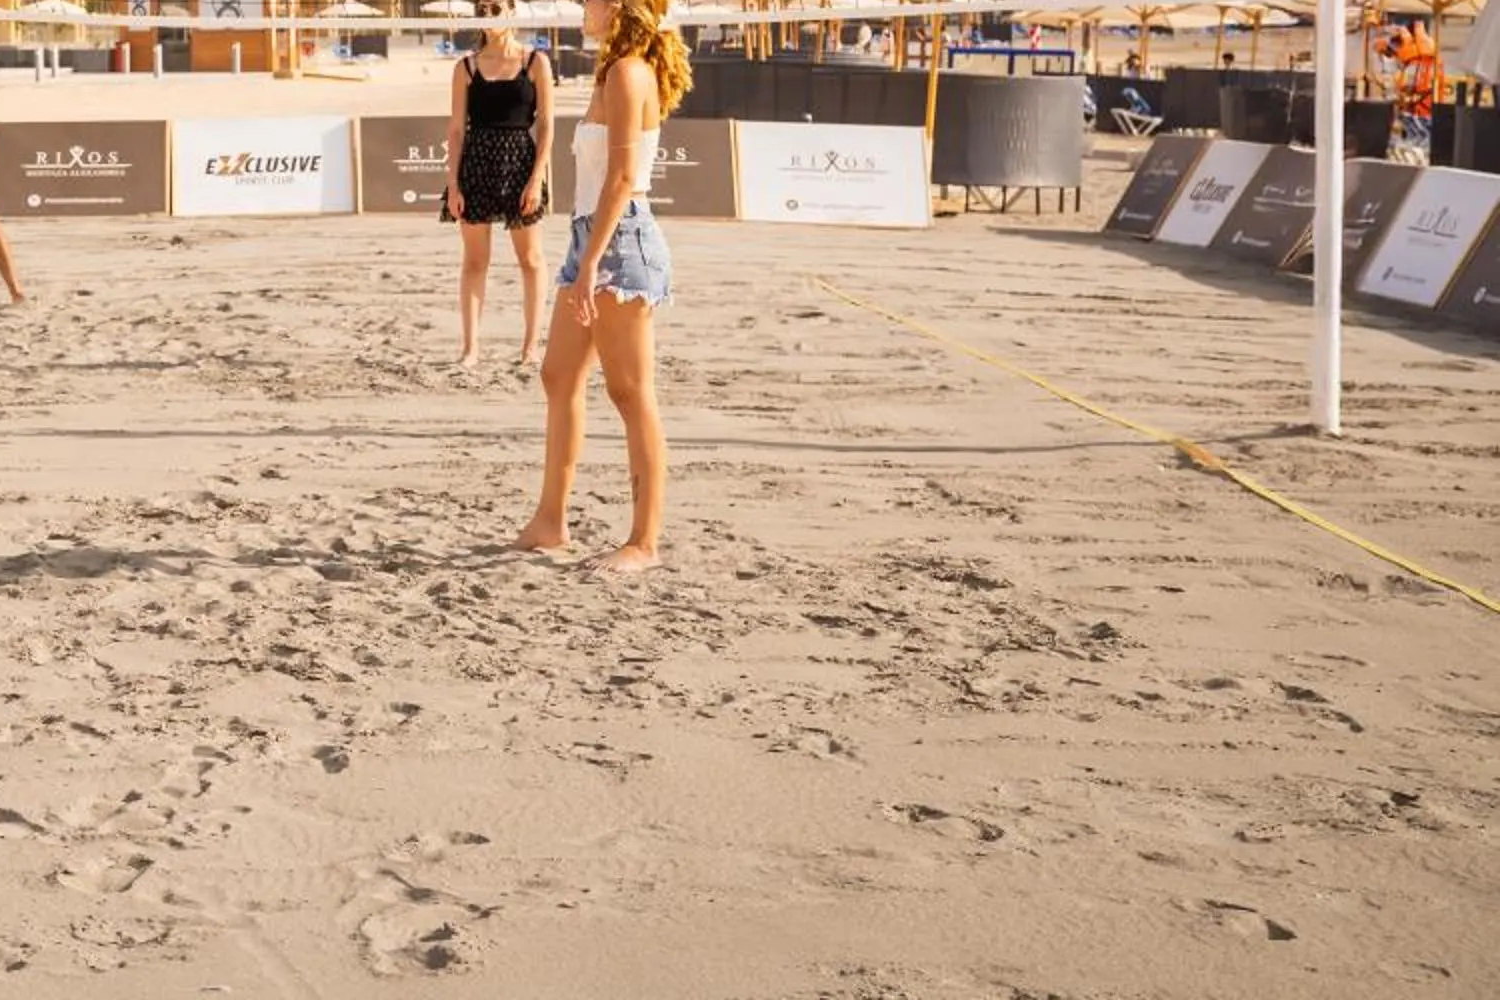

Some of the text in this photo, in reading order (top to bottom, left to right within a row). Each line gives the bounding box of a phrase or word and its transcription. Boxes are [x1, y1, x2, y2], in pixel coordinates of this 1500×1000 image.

[36, 145, 120, 168] RIXOS
[205, 152, 322, 176] EXCLUSIVE
[791, 150, 876, 171] RIXOS
